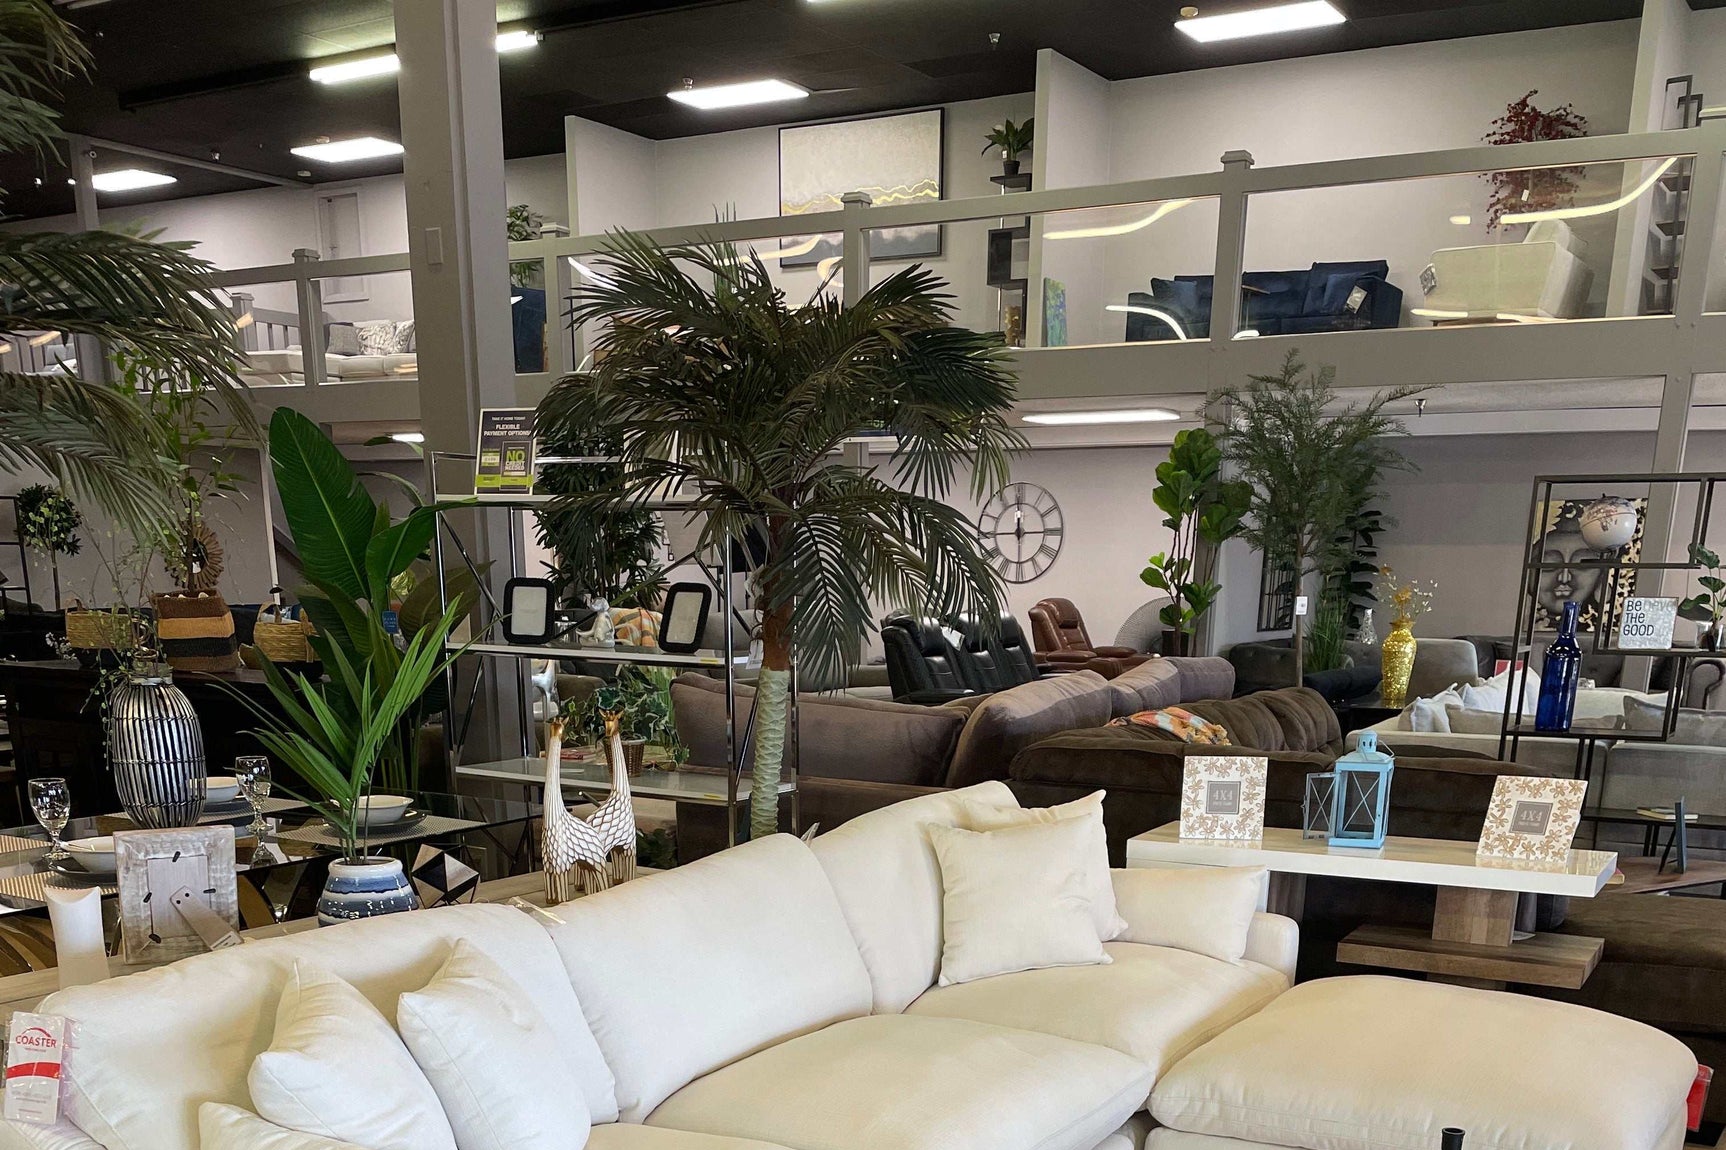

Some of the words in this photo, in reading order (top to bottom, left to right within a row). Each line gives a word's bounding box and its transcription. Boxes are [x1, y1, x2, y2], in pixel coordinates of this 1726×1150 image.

[506, 450, 526, 462] NO
[1622, 624, 1655, 637] GOOD
[1520, 810, 1543, 822] 4X4
[15, 1035, 57, 1048] COASTER
